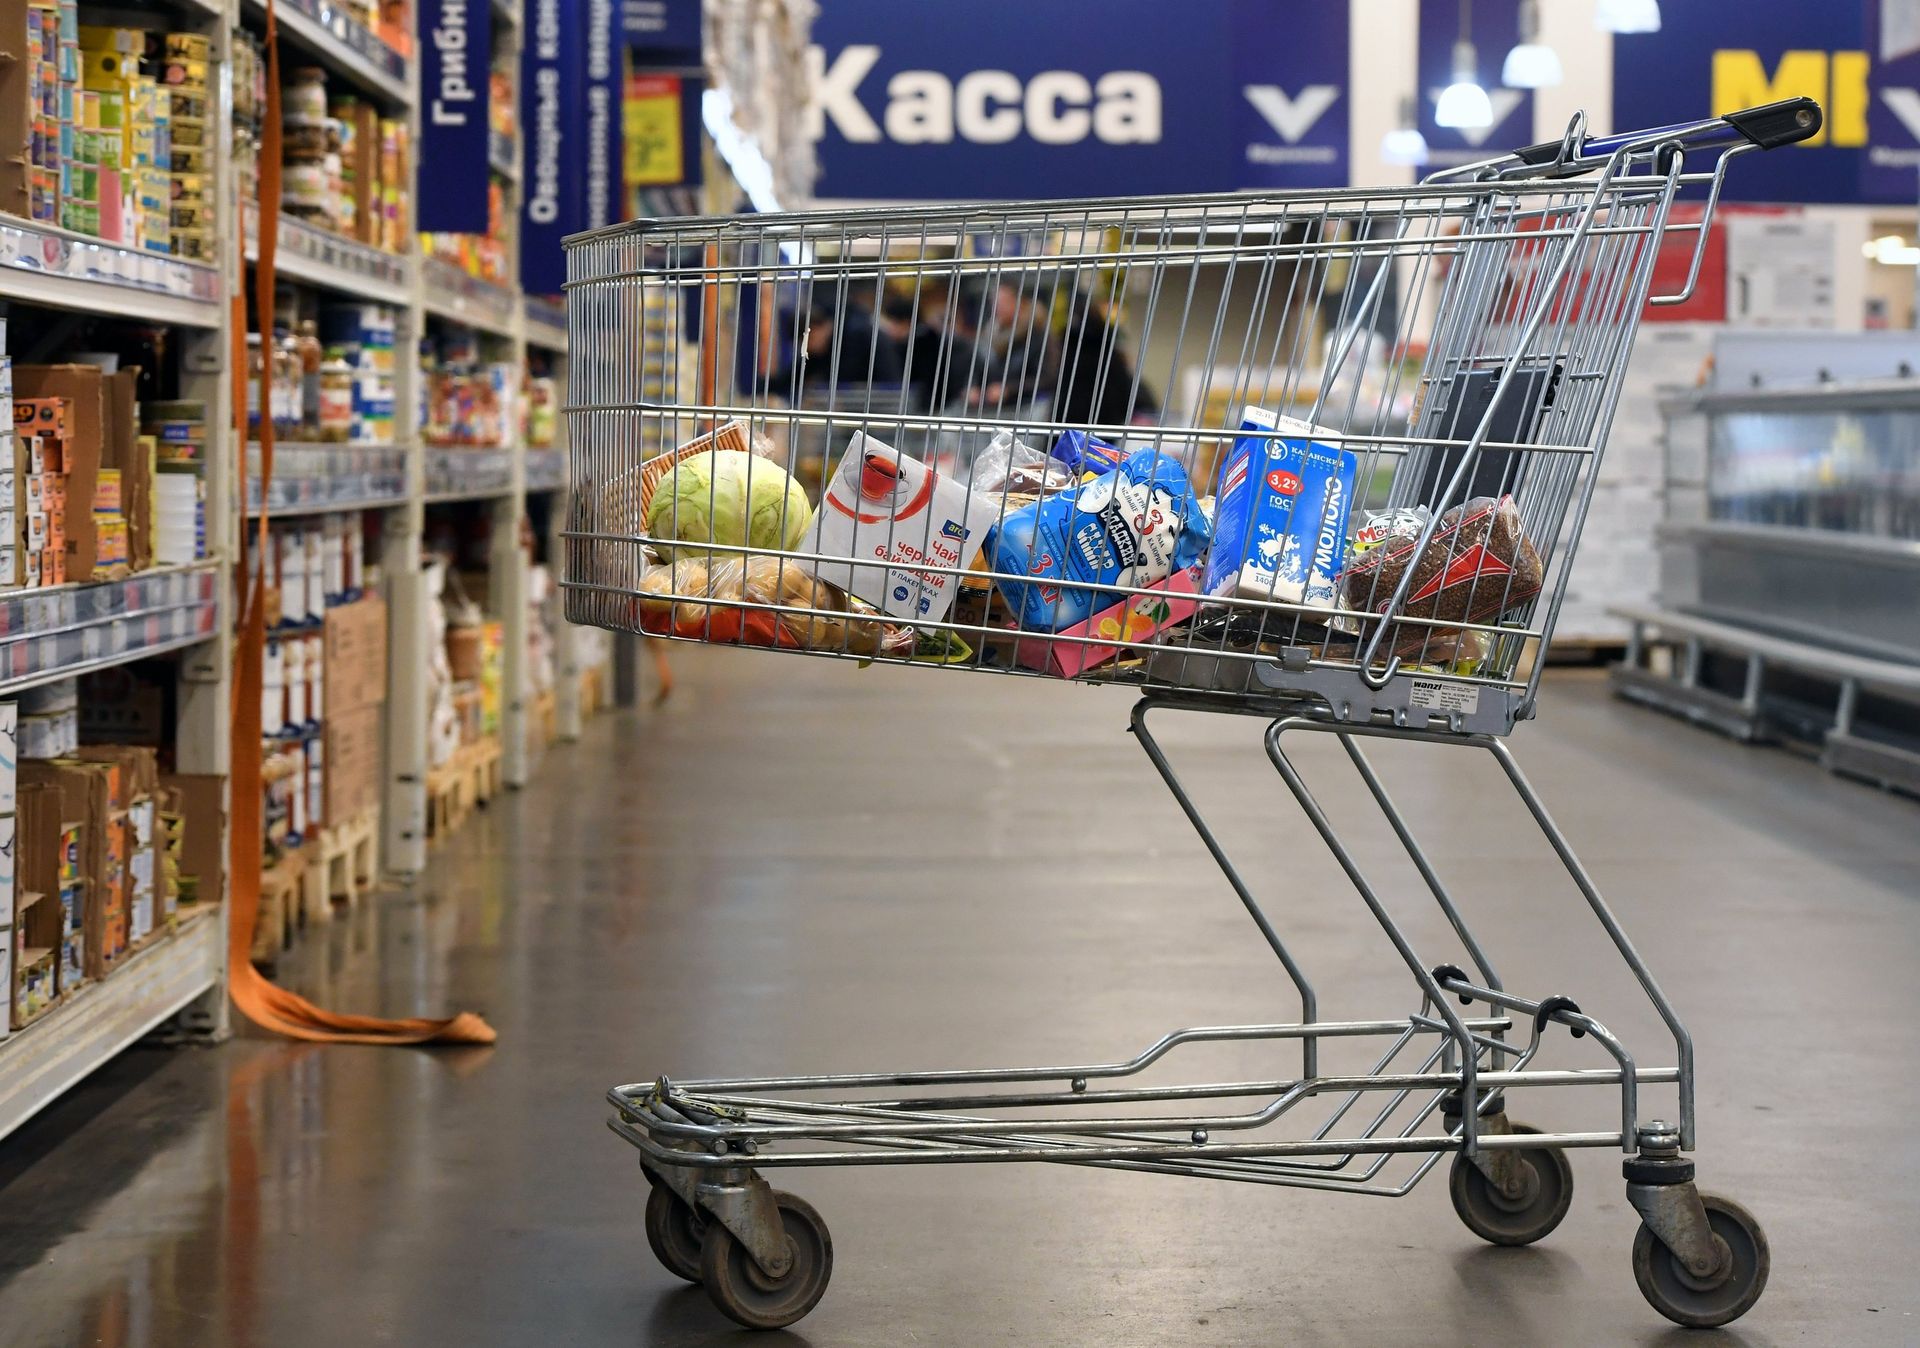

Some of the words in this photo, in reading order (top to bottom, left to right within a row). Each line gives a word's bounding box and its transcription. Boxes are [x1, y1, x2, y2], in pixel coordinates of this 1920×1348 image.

[432, 0, 475, 125] Грибн
[808, 44, 1163, 144] Касса
[1077, 522, 1115, 570] САХАР
[1100, 509, 1135, 566] СЛАДКИЙ
[1134, 509, 1164, 535] 3
[1315, 476, 1343, 570] МОЛОКО
[932, 540, 959, 563] Чай
[1413, 681, 1442, 690] wanzl
